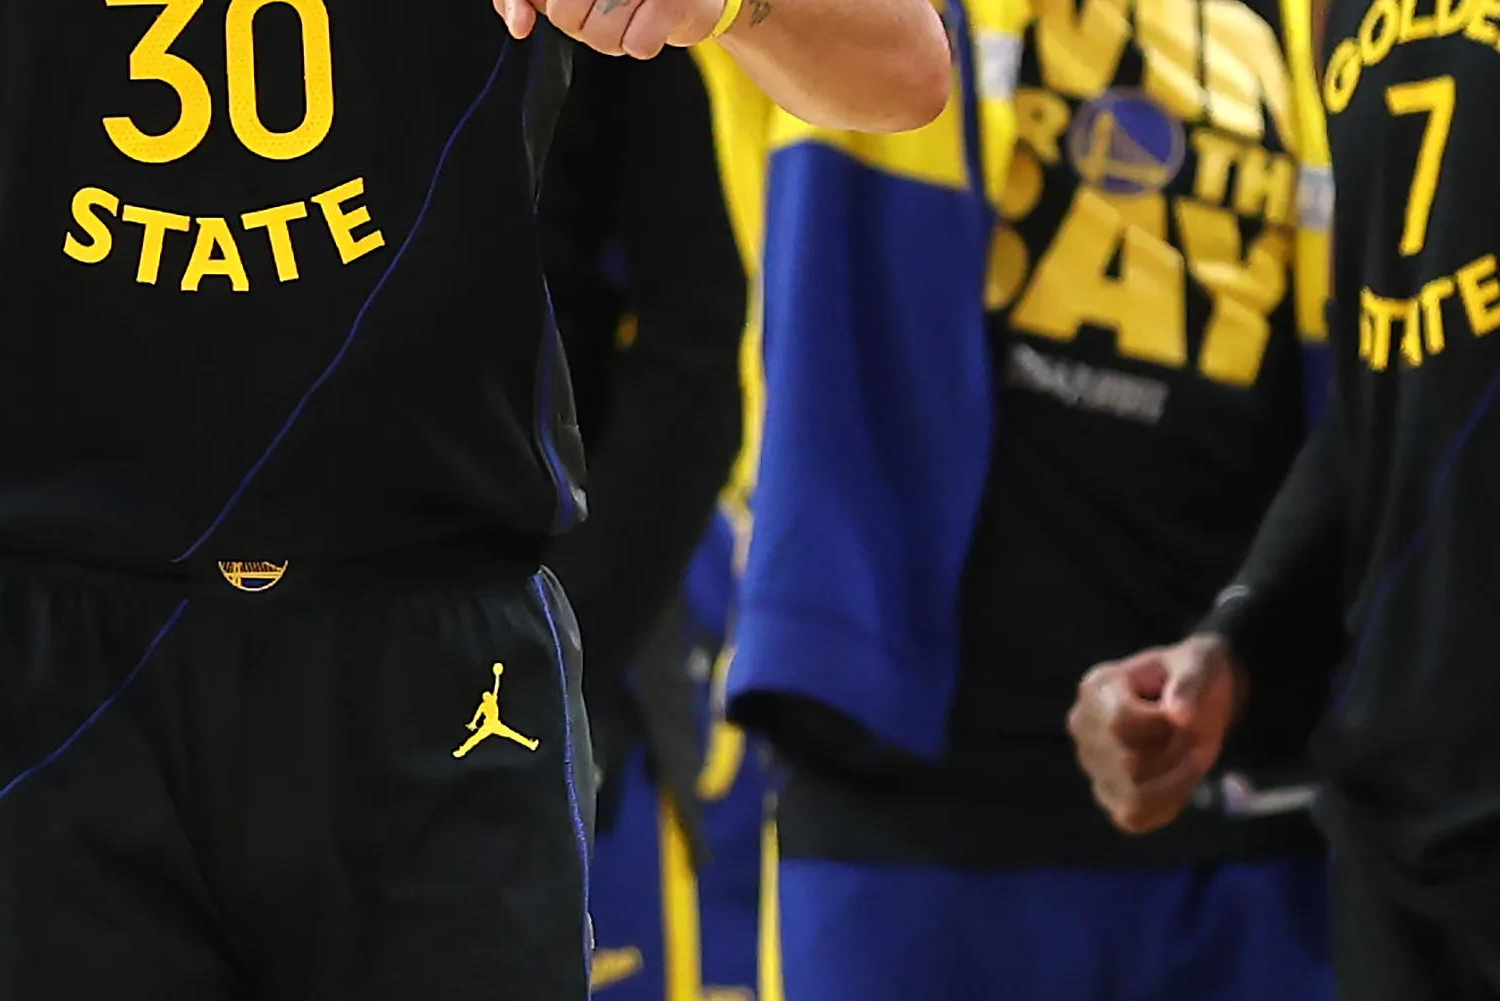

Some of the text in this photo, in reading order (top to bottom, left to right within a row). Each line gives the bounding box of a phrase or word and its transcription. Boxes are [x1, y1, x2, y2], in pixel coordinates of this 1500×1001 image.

[1192, 126, 1296, 228] TH
[1384, 74, 1457, 257] 7
[62, 177, 386, 292] STATE
